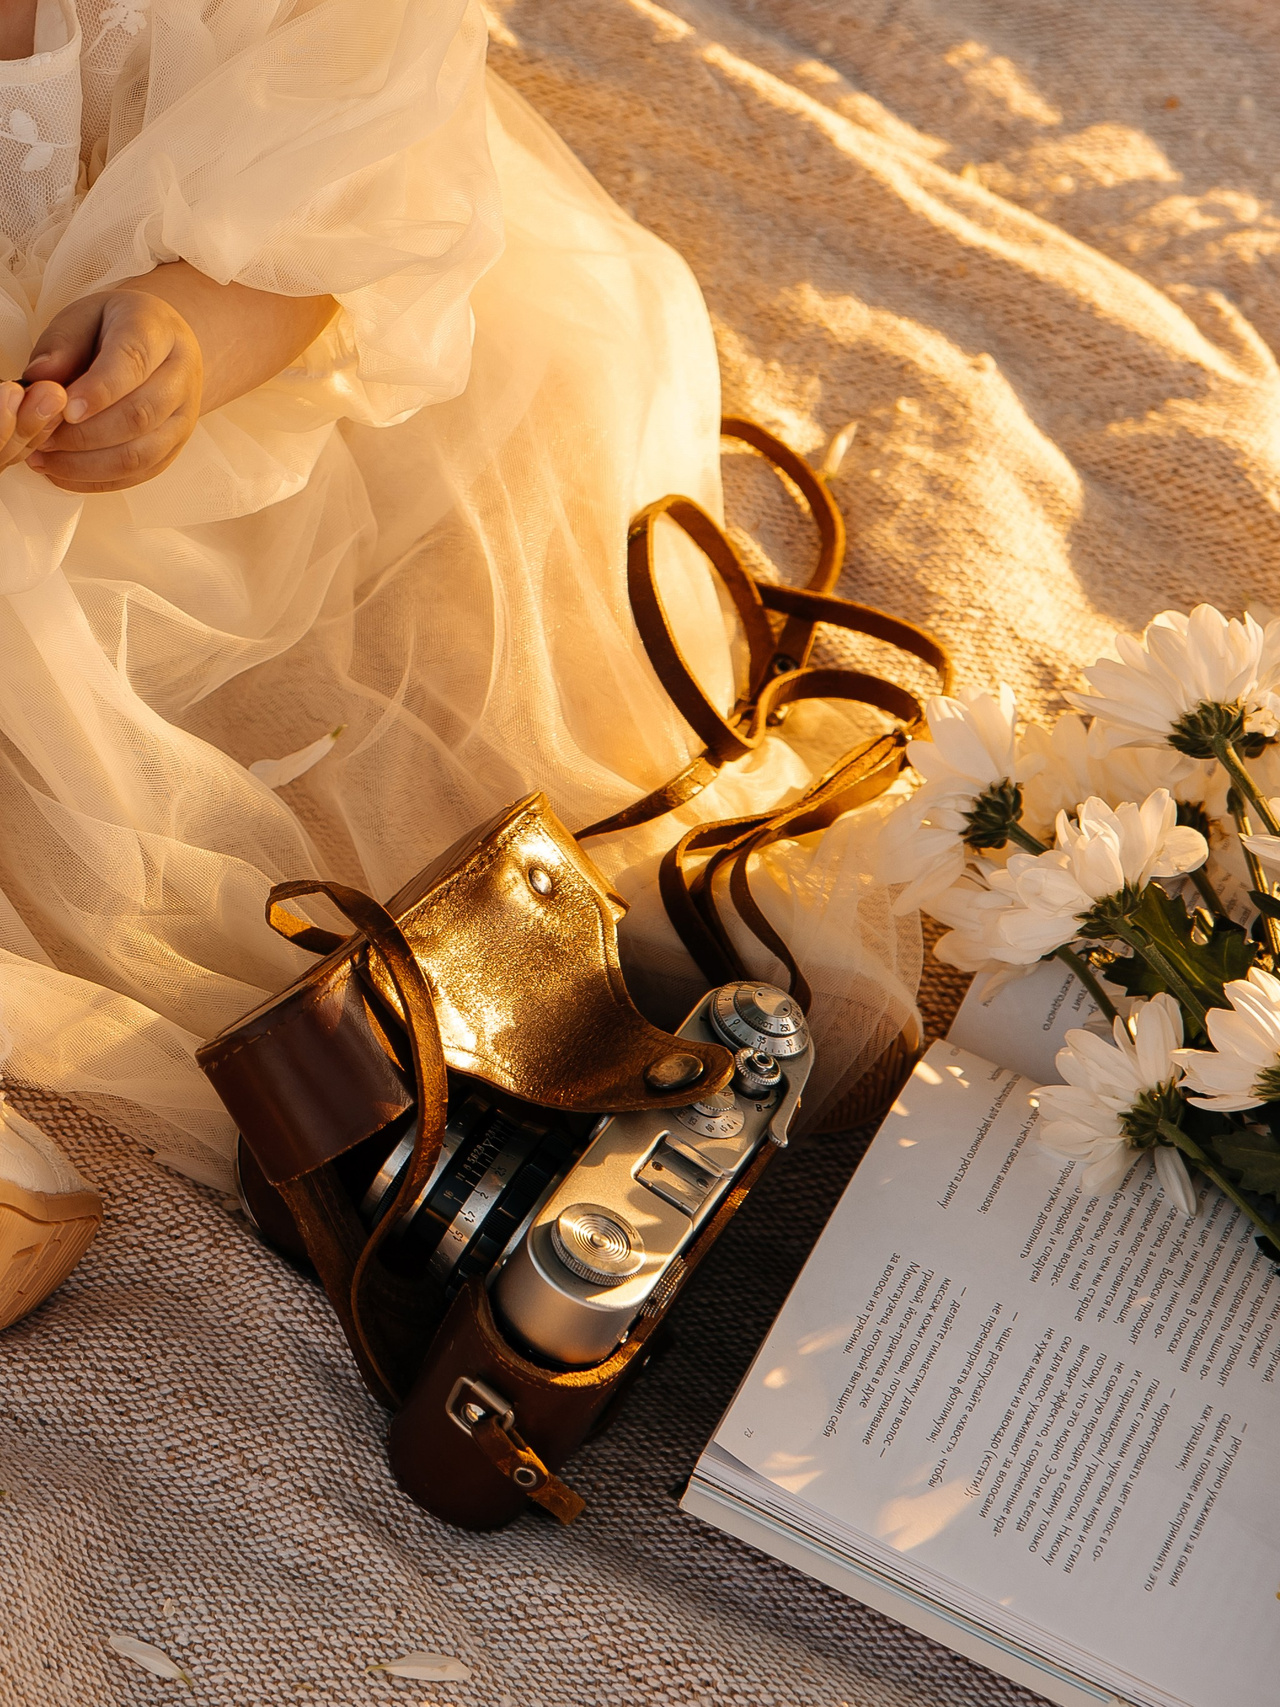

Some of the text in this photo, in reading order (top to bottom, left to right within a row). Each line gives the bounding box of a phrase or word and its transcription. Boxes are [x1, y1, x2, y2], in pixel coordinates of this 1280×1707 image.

[756, 1035, 767, 1044] 35
[1043, 973, 1074, 1031] ежегодного
[965, 1116, 993, 1159] уверенного
[987, 1105, 999, 1120] для
[935, 1180, 959, 1210] длину
[952, 1155, 971, 1182] роста
[975, 1122, 1032, 1215] учетом свежих анализов;
[1130, 1181, 1153, 1207] Бытует
[1018, 1185, 1062, 1259] нужно дополнить
[1028, 1192, 1080, 1283] природой, следуем
[1049, 1221, 1086, 1287] любом возрас-
[1067, 1191, 1126, 1291] быть волосы, но, на мой
[1096, 1196, 1162, 1323] здоровье волос становится на-
[1097, 1255, 1113, 1272] чем
[1106, 1239, 1121, 1254] что
[1111, 1219, 1172, 1324] сорока, иногда раньше,
[1112, 1205, 1137, 1237] мнение,
[841, 1251, 901, 1354] за волосы из трясины.
[1073, 1287, 1096, 1322] старше
[1090, 1271, 1104, 1287] мы
[1127, 1228, 1189, 1345] не зубы». Волосы проходят
[1153, 1218, 1215, 1339] ни цвет, ни длину, ничего во-
[1165, 1242, 1225, 1355] экспериментов. поисках
[1178, 1244, 1245, 1373] полжизни наши исследования
[1198, 1270, 1255, 1381] исследователь наших во-
[821, 1260, 921, 1438] Мюнхгаузена, который вытащил себя
[858, 1268, 935, 1408] гривой, йога-практика духе
[861, 1276, 952, 1445] массаж кожи головы, потряхивание
[882, 1298, 961, 1446] делайте гимнастику для волос
[924, 1301, 1003, 1443] не перенапрягать фолликулы;
[1215, 1293, 1265, 1388] характер проводят
[1246, 1322, 1273, 1369] окружают
[744, 1427, 754, 1440] 73
[926, 1326, 1013, 1488] чаще распускайте «хвост», чтобы
[963, 1326, 1055, 1498] не хуже маски из авокадо (кстати!);
[977, 1335, 1072, 1518] ски для волос ухаживают за волосами
[992, 1343, 1090, 1538] выглядит эффектно, современные кра-
[1014, 1351, 1107, 1532] потому, что это модно. Это не всегда
[1027, 1360, 1125, 1553] не советую переходить седину только
[1173, 1403, 1214, 1471] как праздник;
[1062, 1377, 1160, 1574] гласии личным чувством меры стиля
[1091, 1401, 1171, 1562] корректировать цвет волос со-
[1143, 1412, 1232, 1592] садом на голове воспринимать это
[1167, 1434, 1242, 1587] регулярно ухаживать за своим
[1040, 1523, 1073, 1566] Никому
